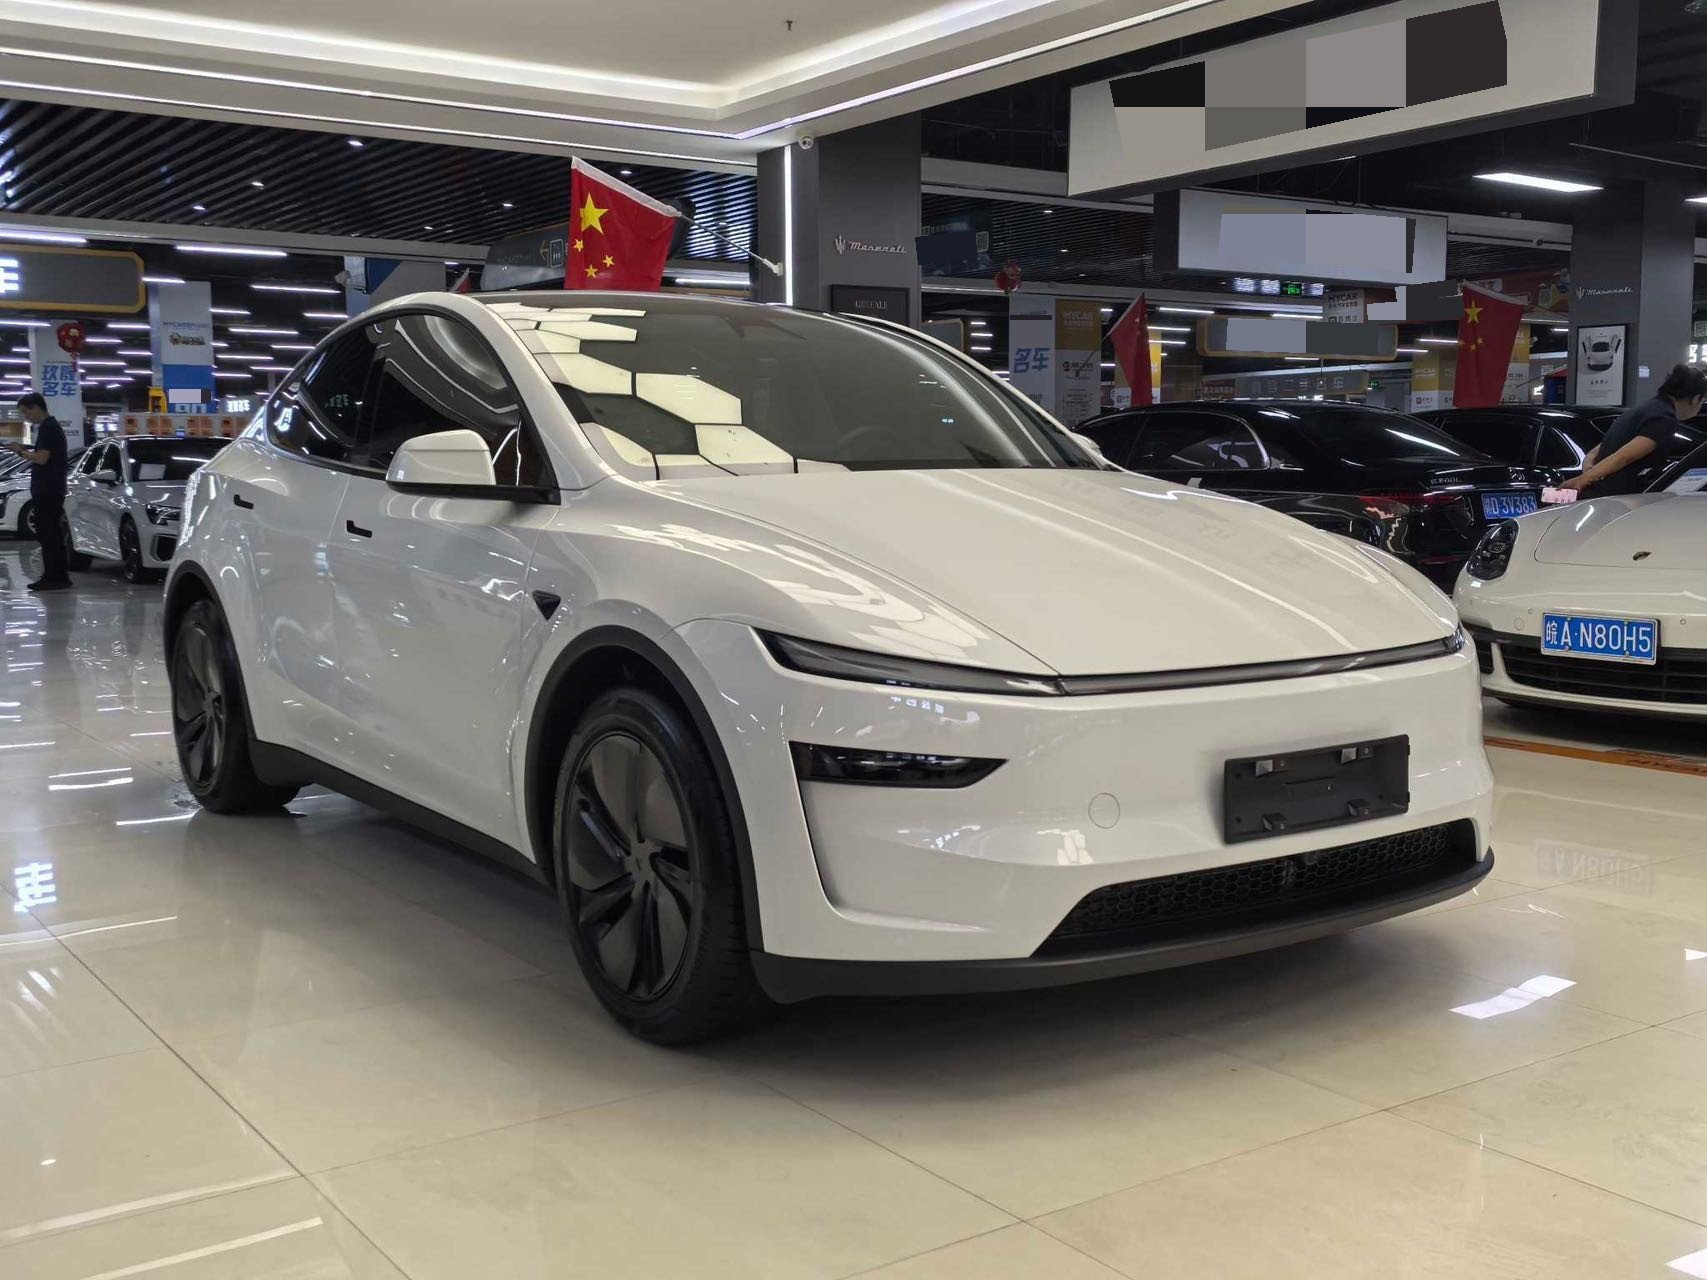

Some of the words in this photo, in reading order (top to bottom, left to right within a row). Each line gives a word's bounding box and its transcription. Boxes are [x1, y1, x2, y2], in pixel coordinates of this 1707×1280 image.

[848, 241, 908, 253] Maserati
[1013, 347, 1051, 374] 名车
[42, 381, 78, 397] 名车
